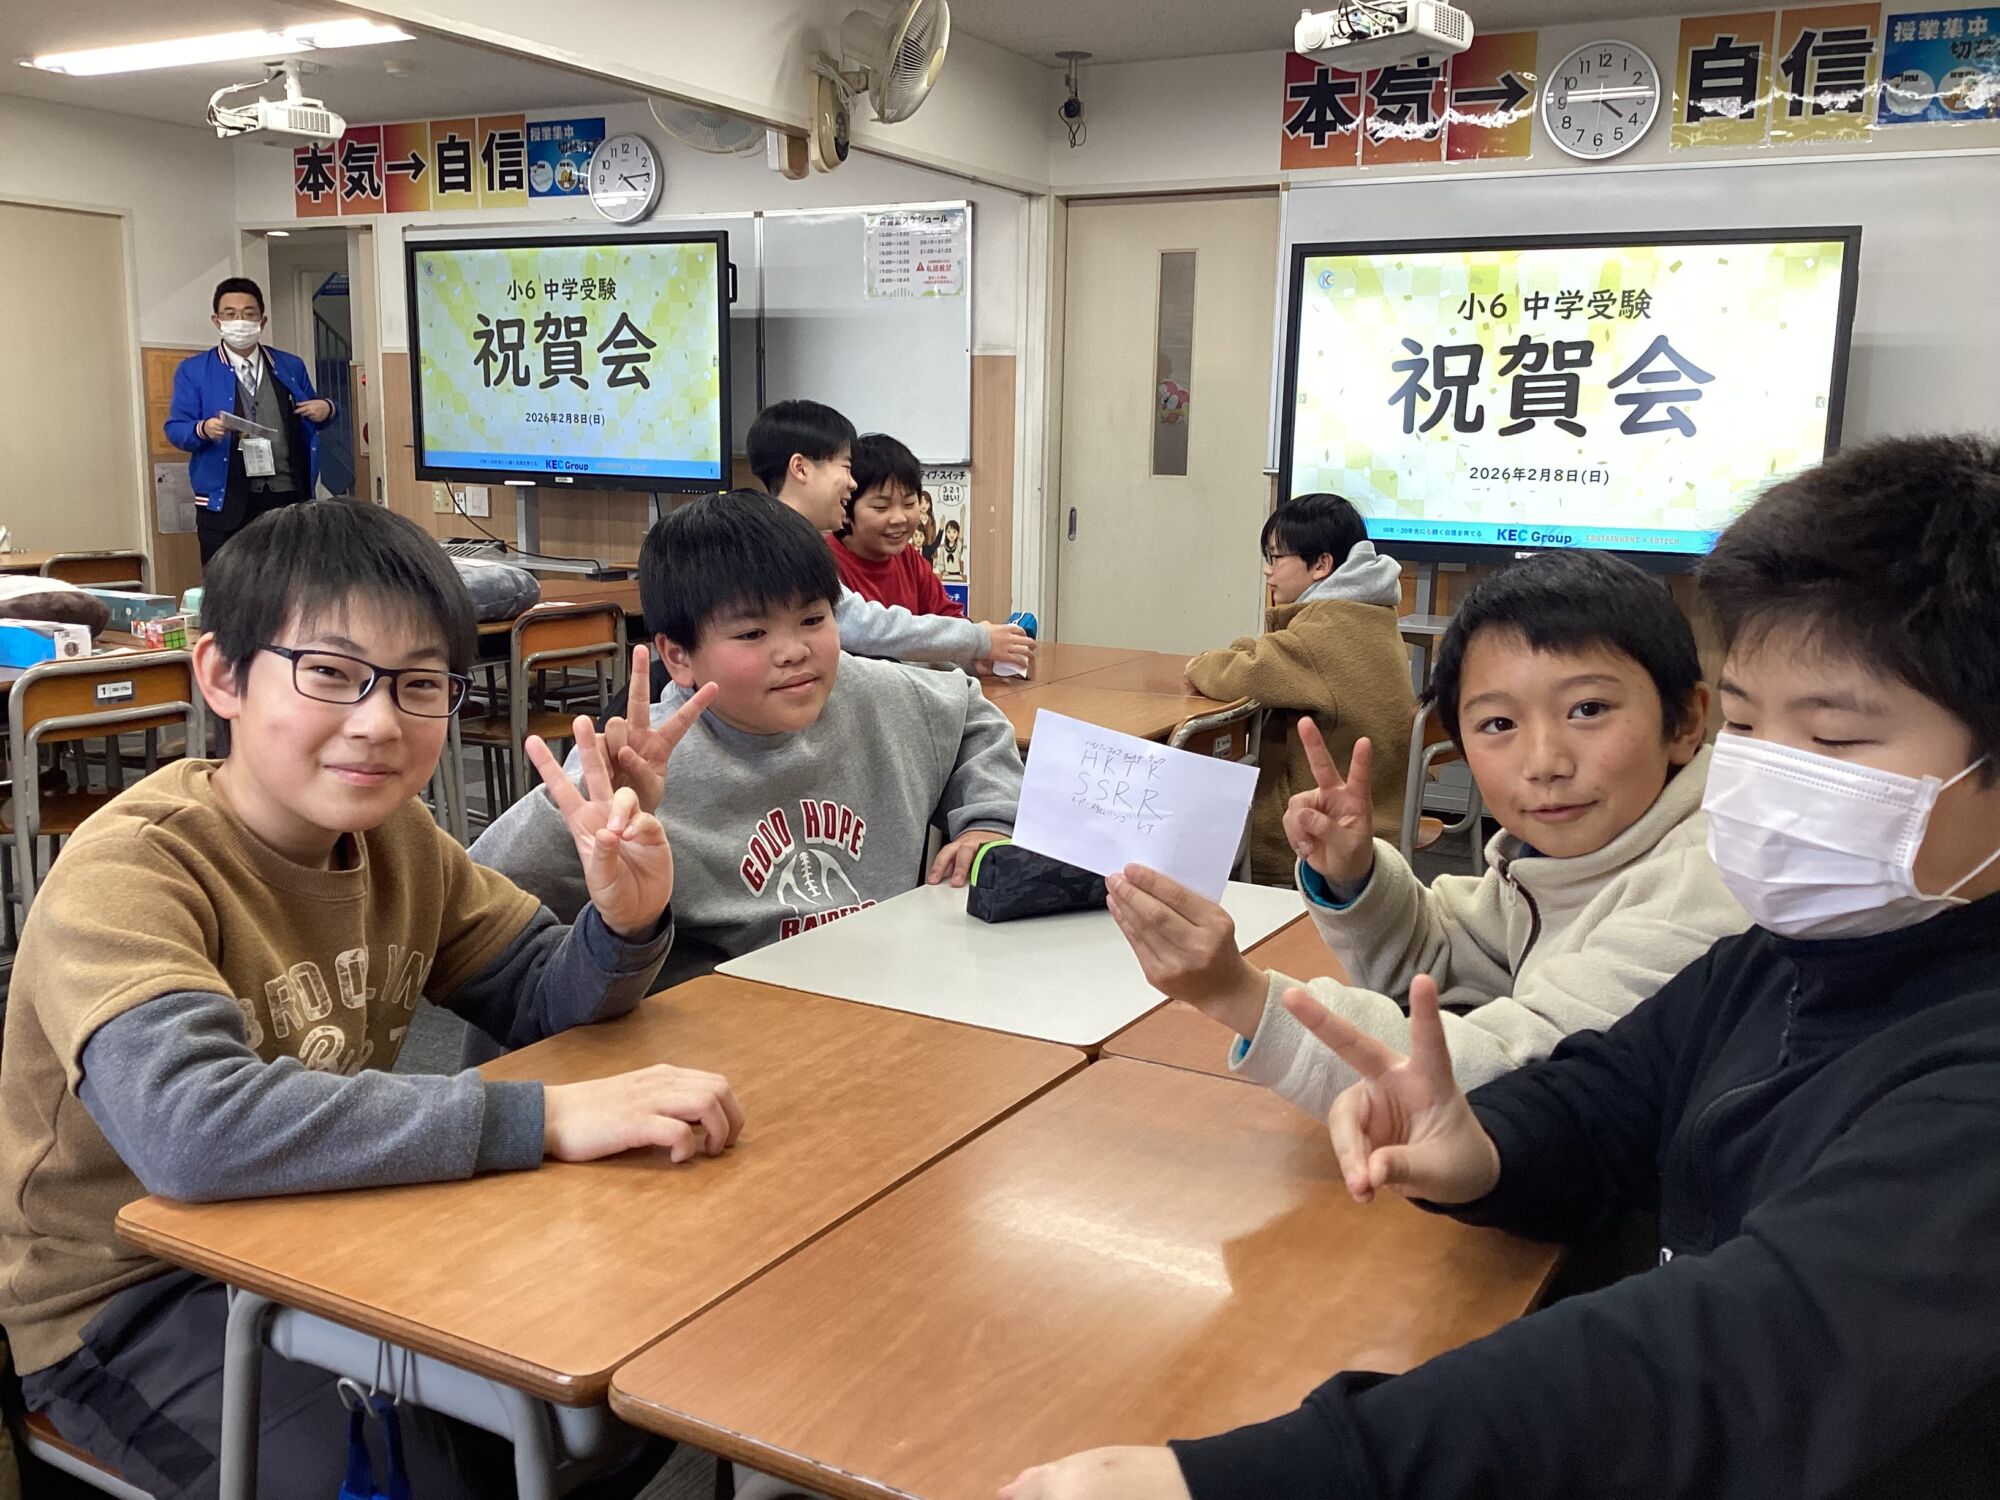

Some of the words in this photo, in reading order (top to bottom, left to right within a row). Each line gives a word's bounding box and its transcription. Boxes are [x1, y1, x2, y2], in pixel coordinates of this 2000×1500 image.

[1893, 15, 1988, 43] 授業集中
[1580, 60, 1590, 74] 11
[1599, 53, 1612, 67] 12
[1623, 58, 1627, 72] 1
[1564, 76, 1577, 90] 10
[1632, 71, 1642, 85] 2
[1284, 65, 1441, 146] 本気
[1687, 26, 1875, 122] 自信
[1557, 96, 1567, 110] 9
[1561, 115, 1572, 129] 8
[1628, 112, 1638, 126] 4
[1576, 128, 1585, 142] 7
[1593, 133, 1603, 146] 6
[1614, 127, 1624, 141] 5
[611, 148, 617, 158] 11
[621, 143, 630, 154] 12
[296, 142, 382, 201] 本気
[436, 131, 525, 195] 自信
[602, 160, 610, 170] 10
[641, 157, 648, 168] 2
[600, 175, 605, 185] 9
[506, 279, 536, 301] 小6
[544, 277, 617, 301] 中学受験
[1456, 292, 1508, 321] 小6
[1522, 289, 1654, 321] 中学受験
[473, 311, 657, 390] 祝賀会
[1387, 333, 1716, 439] 祝賀会
[525, 413, 605, 427] 2026年2月8日(日)
[545, 459, 563, 470] KEC
[565, 460, 589, 471] Group
[1469, 465, 1610, 487] 2026年2月8日(日)
[1497, 529, 1528, 542] KEC
[1531, 531, 1573, 545] Group
[740, 808, 795, 897] GOOD
[800, 799, 867, 862] HOPE
